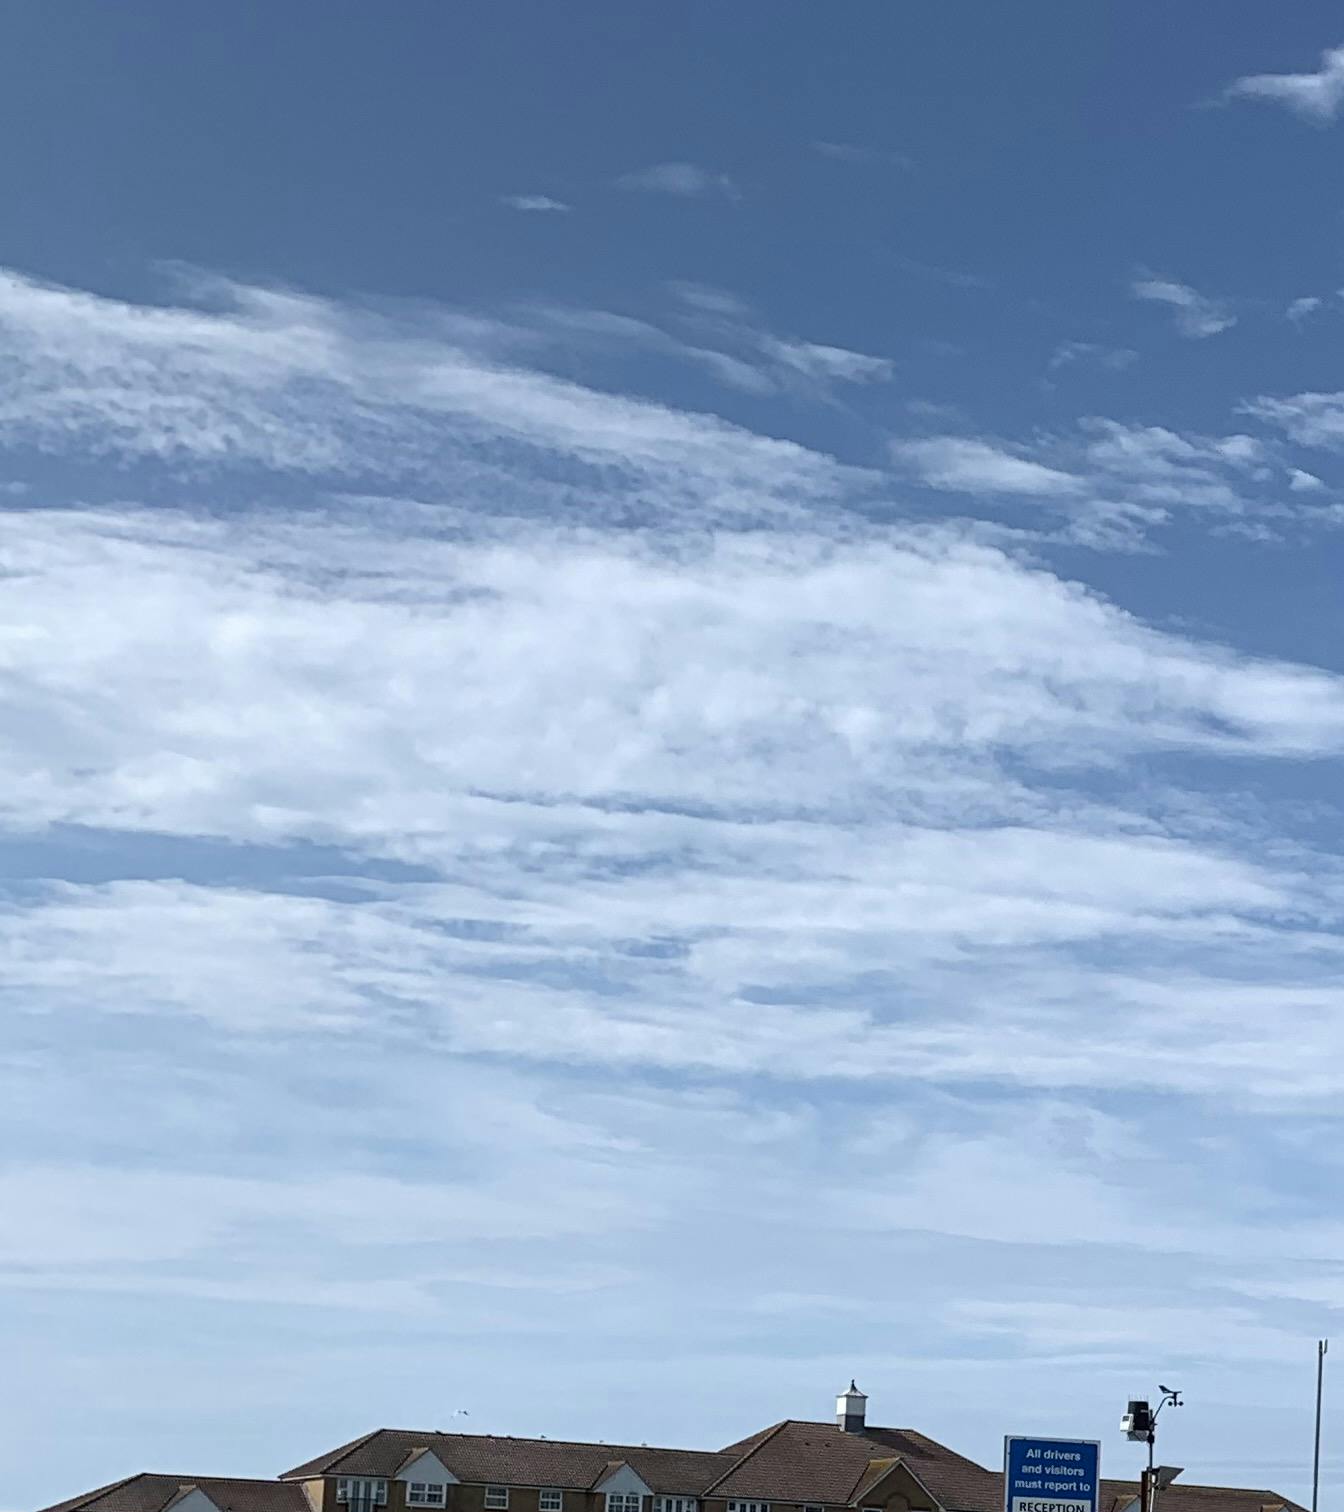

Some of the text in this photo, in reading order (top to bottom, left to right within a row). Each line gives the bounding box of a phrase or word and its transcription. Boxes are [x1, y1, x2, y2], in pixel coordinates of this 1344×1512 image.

[1026, 1448, 1081, 1461] All drivers
[1022, 1465, 1084, 1476] and visitors
[1015, 1480, 1090, 1492] must report to
